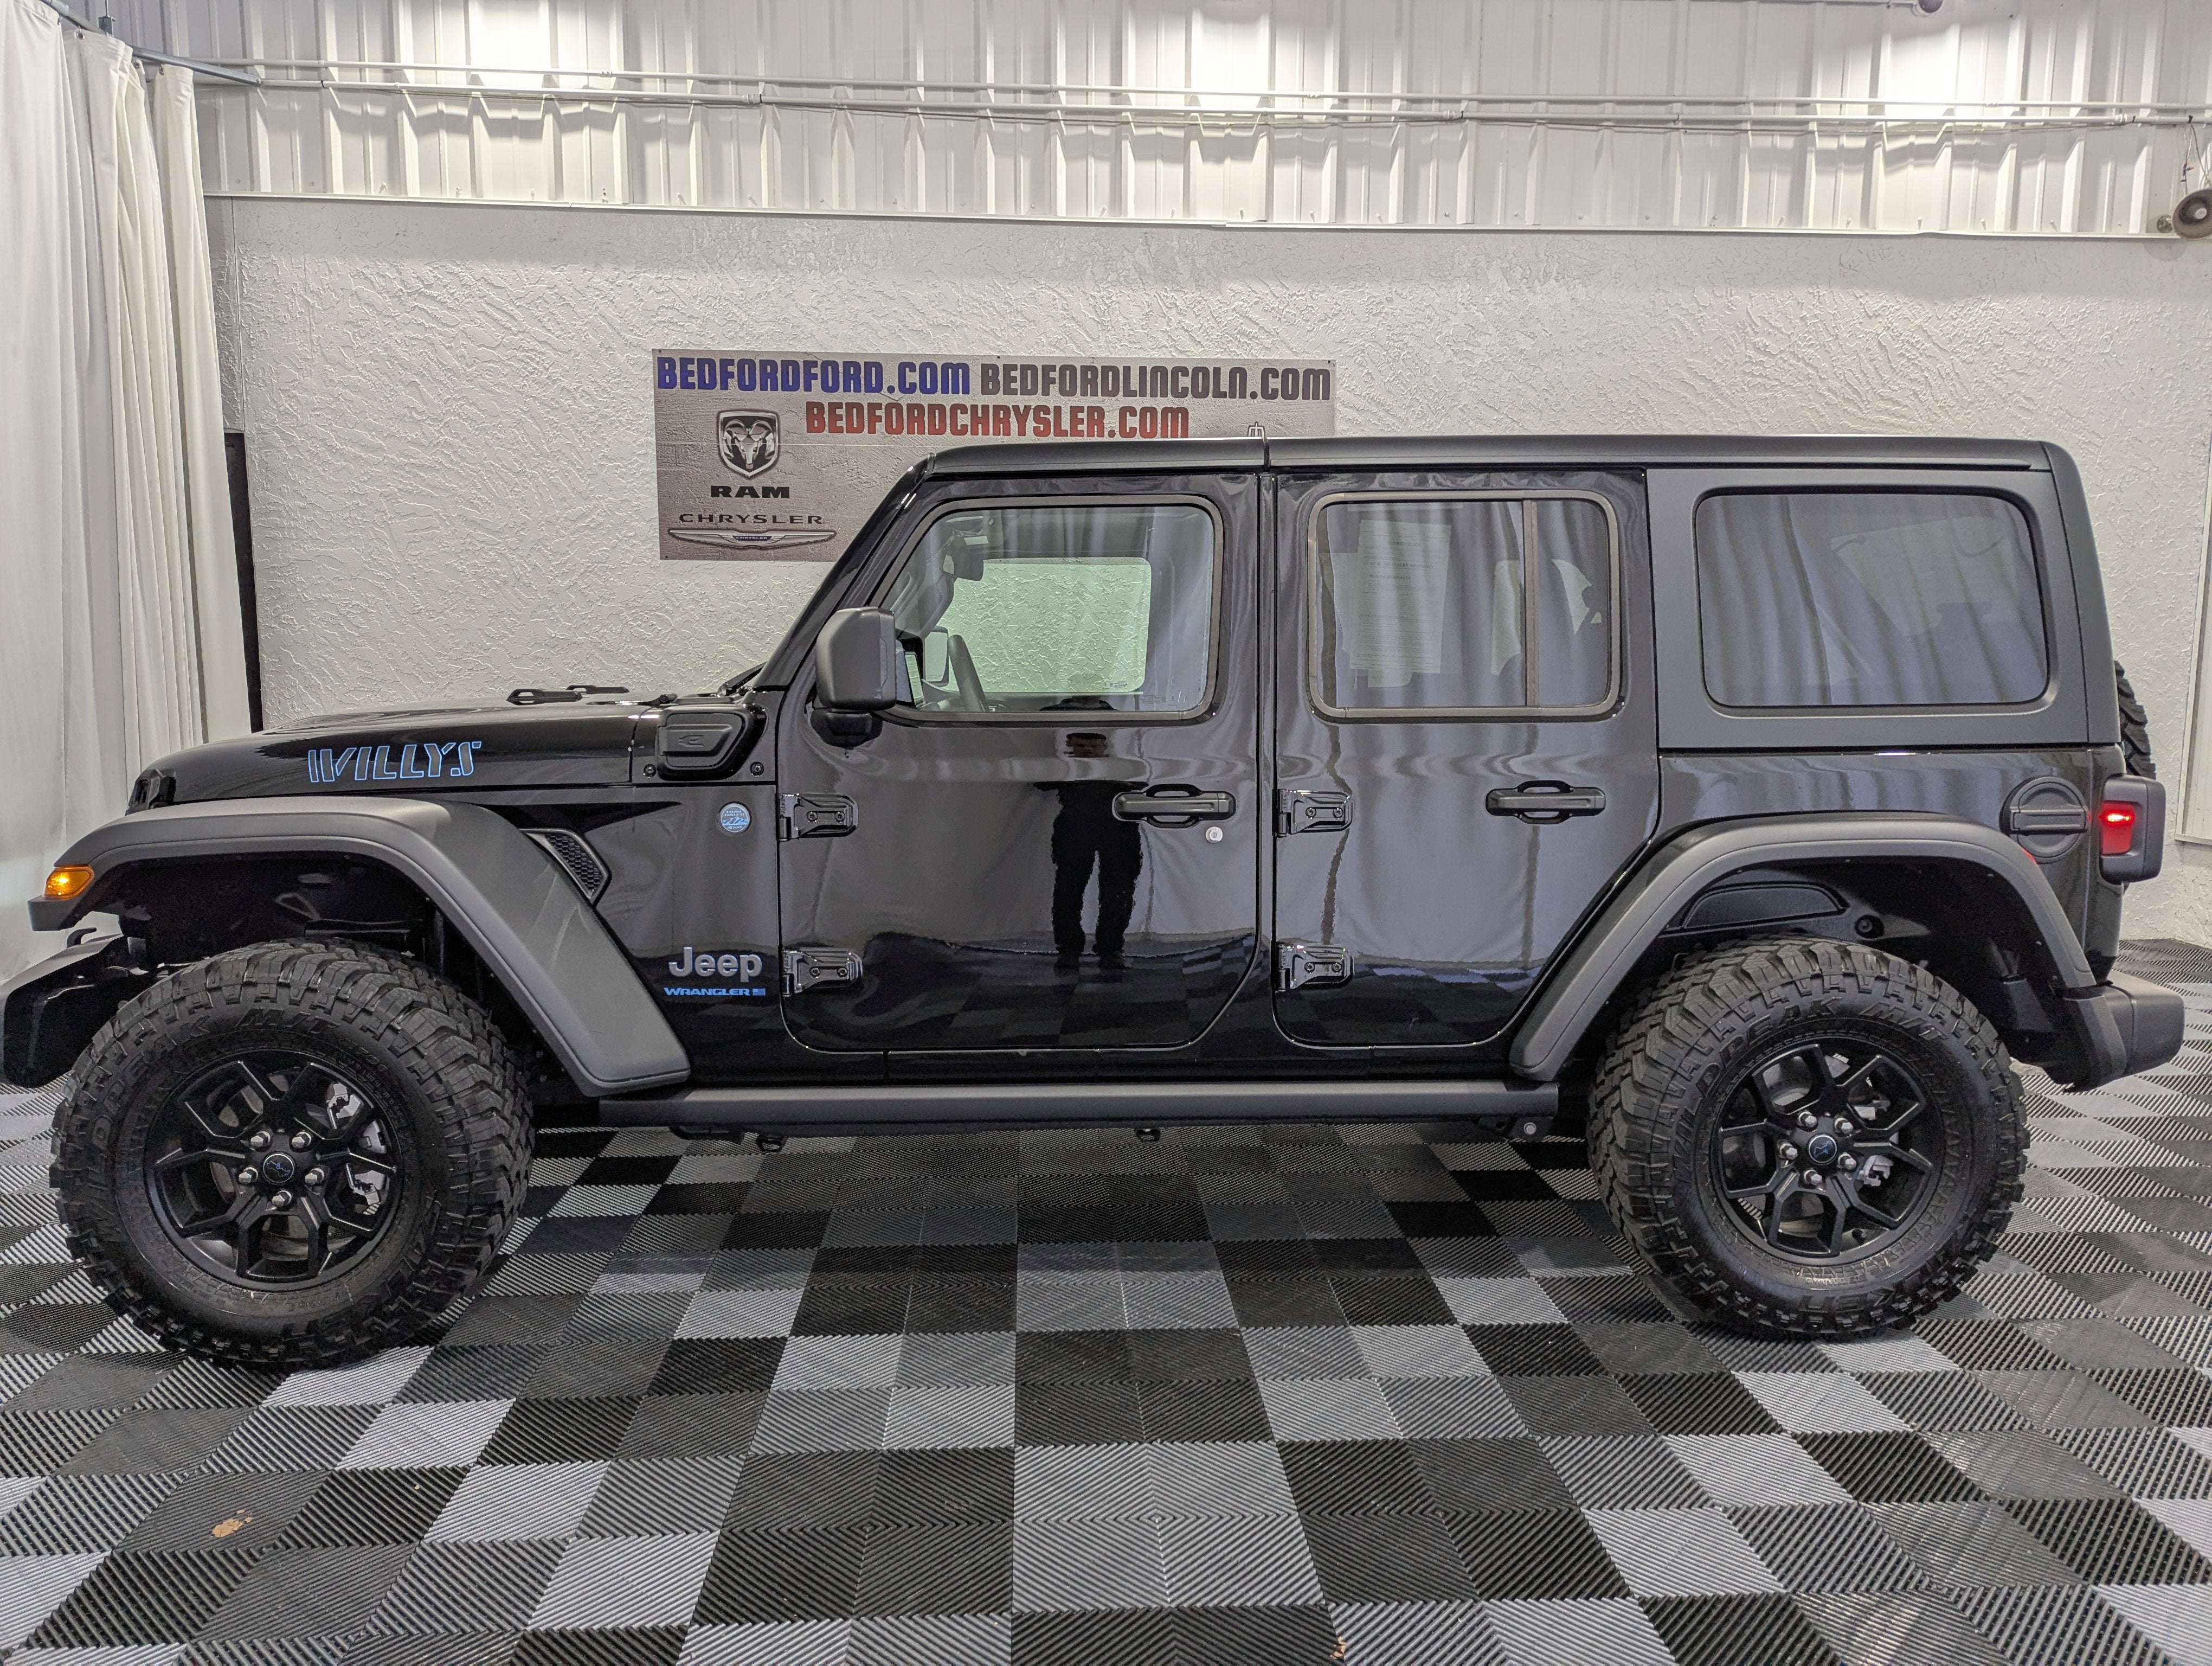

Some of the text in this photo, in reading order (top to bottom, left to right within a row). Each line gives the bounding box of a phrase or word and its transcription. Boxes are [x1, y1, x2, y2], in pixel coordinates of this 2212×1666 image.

[658, 357, 1330, 401] BEDFORDFORD.COM BEDFORDLINCOLN.COM
[806, 401, 1189, 438] BEDFORDCHRYSLER.COM
[711, 485, 790, 498] RAM
[679, 514, 822, 524] CHRYSLER
[307, 741, 482, 783] WILLYS
[668, 947, 762, 983] Jeep
[664, 987, 750, 996] WRANGLER
